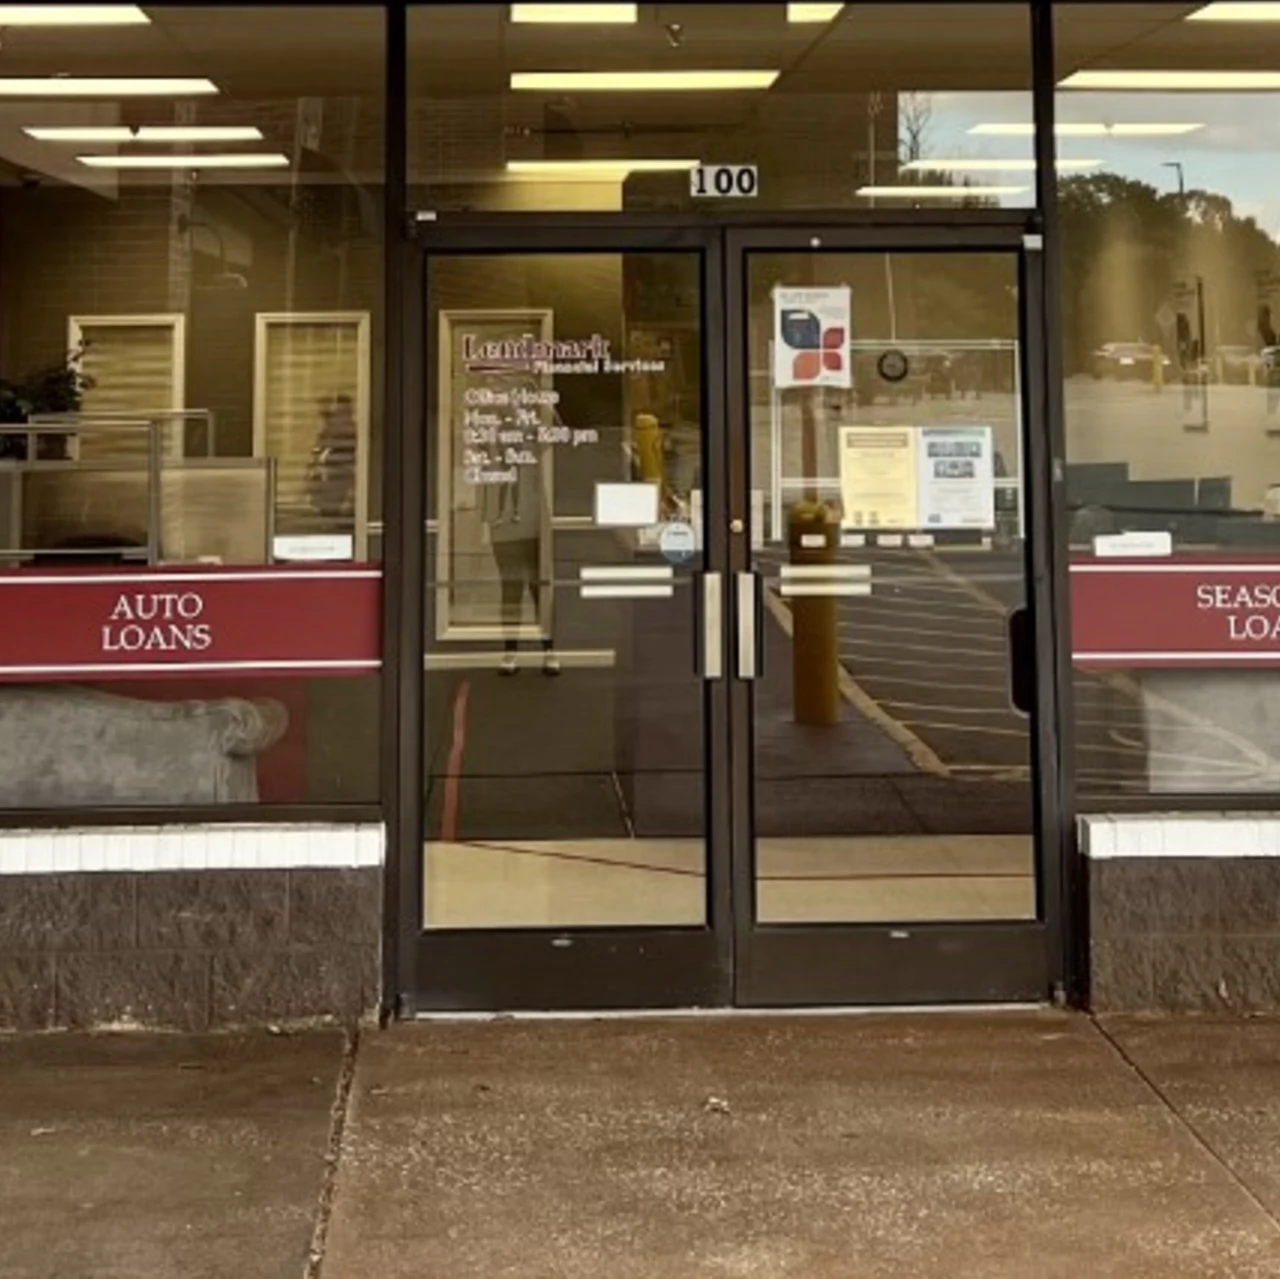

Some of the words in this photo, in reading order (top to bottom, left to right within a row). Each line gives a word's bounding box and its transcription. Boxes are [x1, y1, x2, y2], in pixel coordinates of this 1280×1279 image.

[696, 167, 756, 194] 100
[110, 593, 204, 621] AUTO
[101, 624, 213, 651] LOANS
